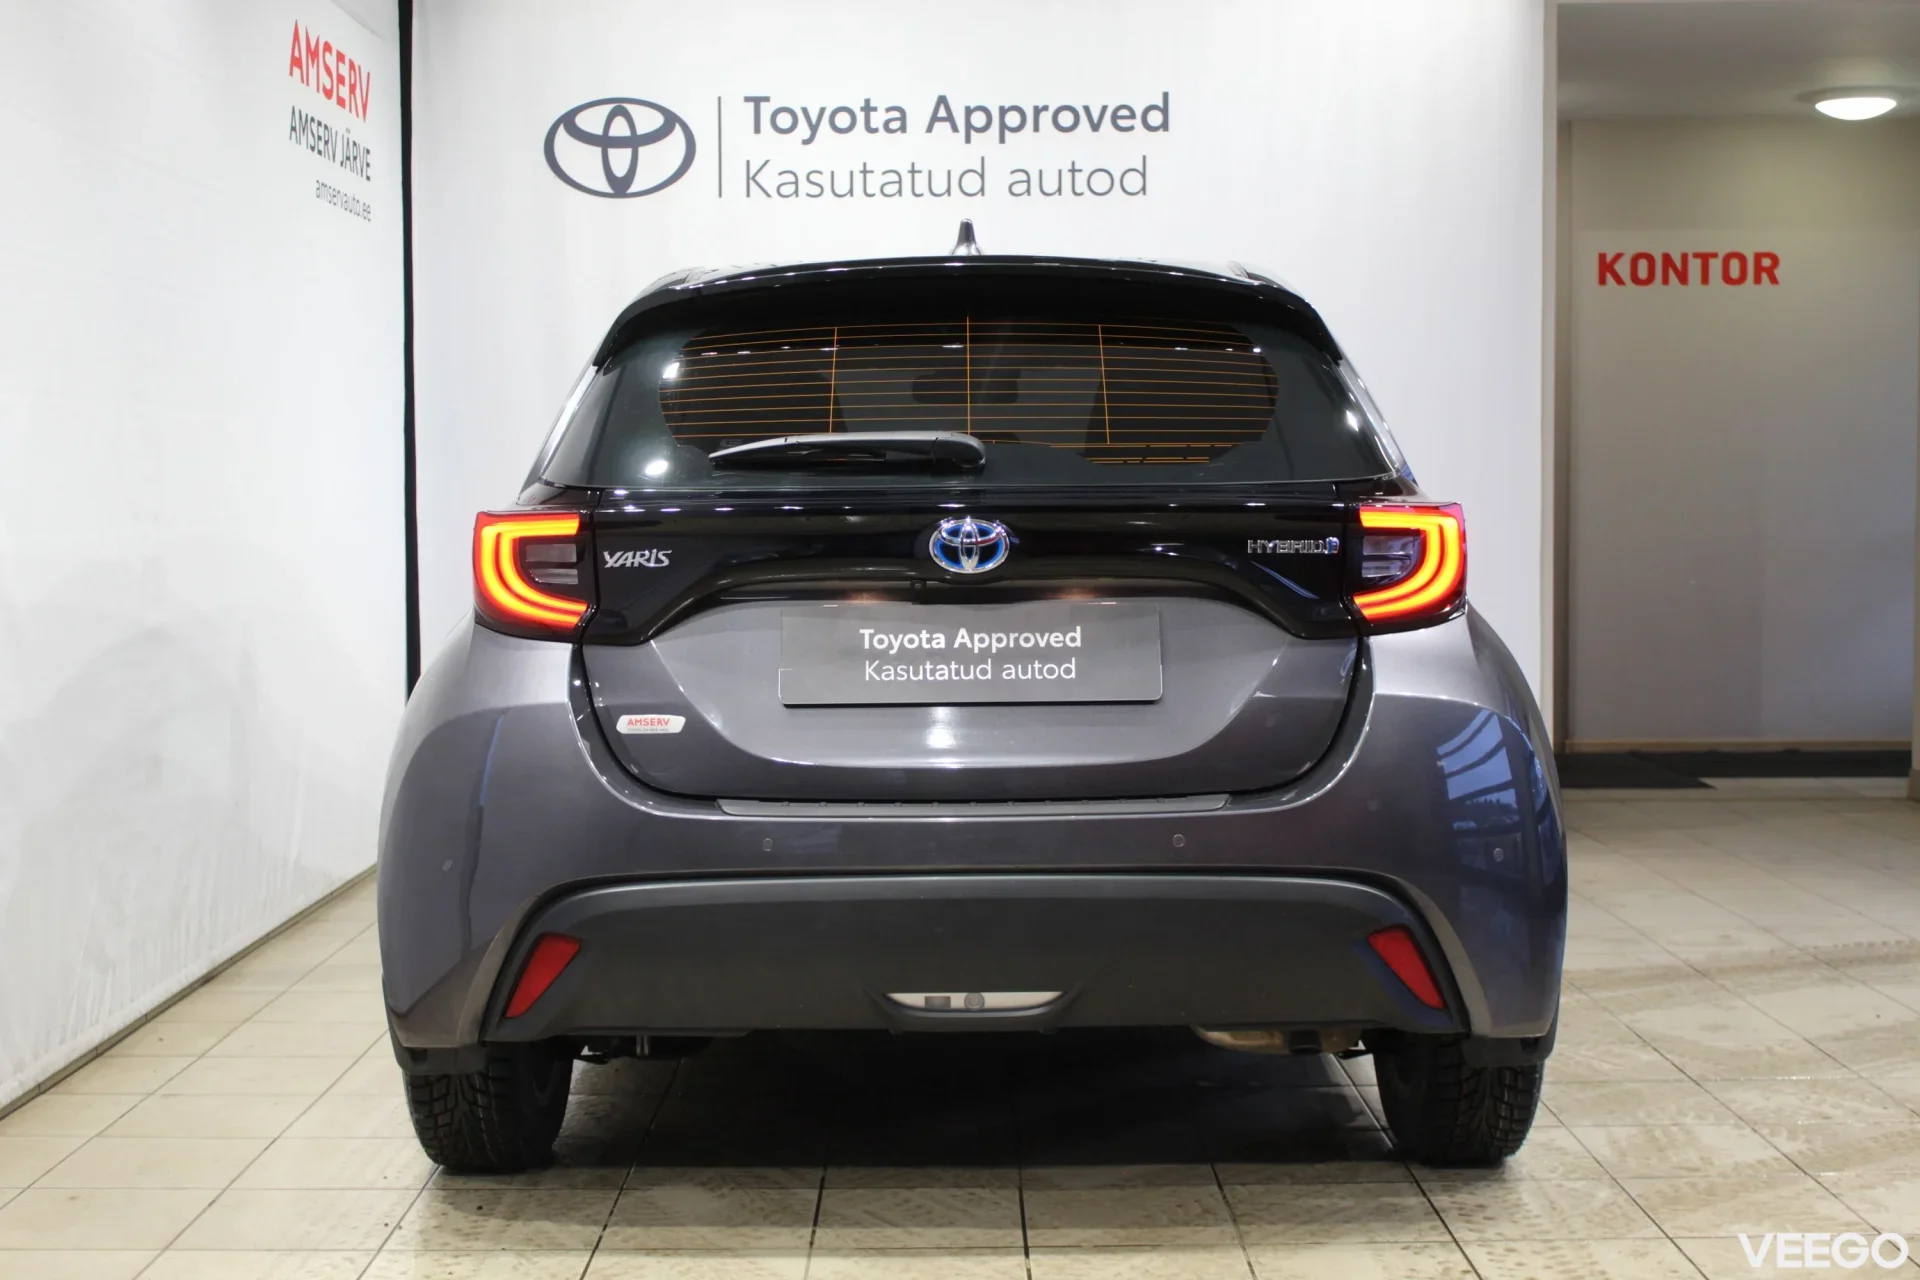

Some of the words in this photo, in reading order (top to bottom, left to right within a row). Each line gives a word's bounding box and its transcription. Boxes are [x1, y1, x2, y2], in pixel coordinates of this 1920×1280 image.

[289, 19, 370, 122] AMSERV
[743, 95, 908, 145] Toyota
[925, 92, 1170, 144] Approved
[289, 105, 338, 163] AMSERV
[340, 127, 371, 181] JÄRVE
[746, 156, 986, 198] Kasutatud
[1008, 155, 1148, 197] autod
[315, 179, 371, 222] amservauto.ee
[1598, 252, 1780, 286] KONTOR
[1247, 539, 1325, 554] HYBRID
[859, 628, 946, 654] Toyota
[953, 626, 1082, 653] Approved
[864, 659, 992, 681] Kasutatud
[1002, 657, 1076, 679] autod
[627, 717, 670, 726] AMSERV
